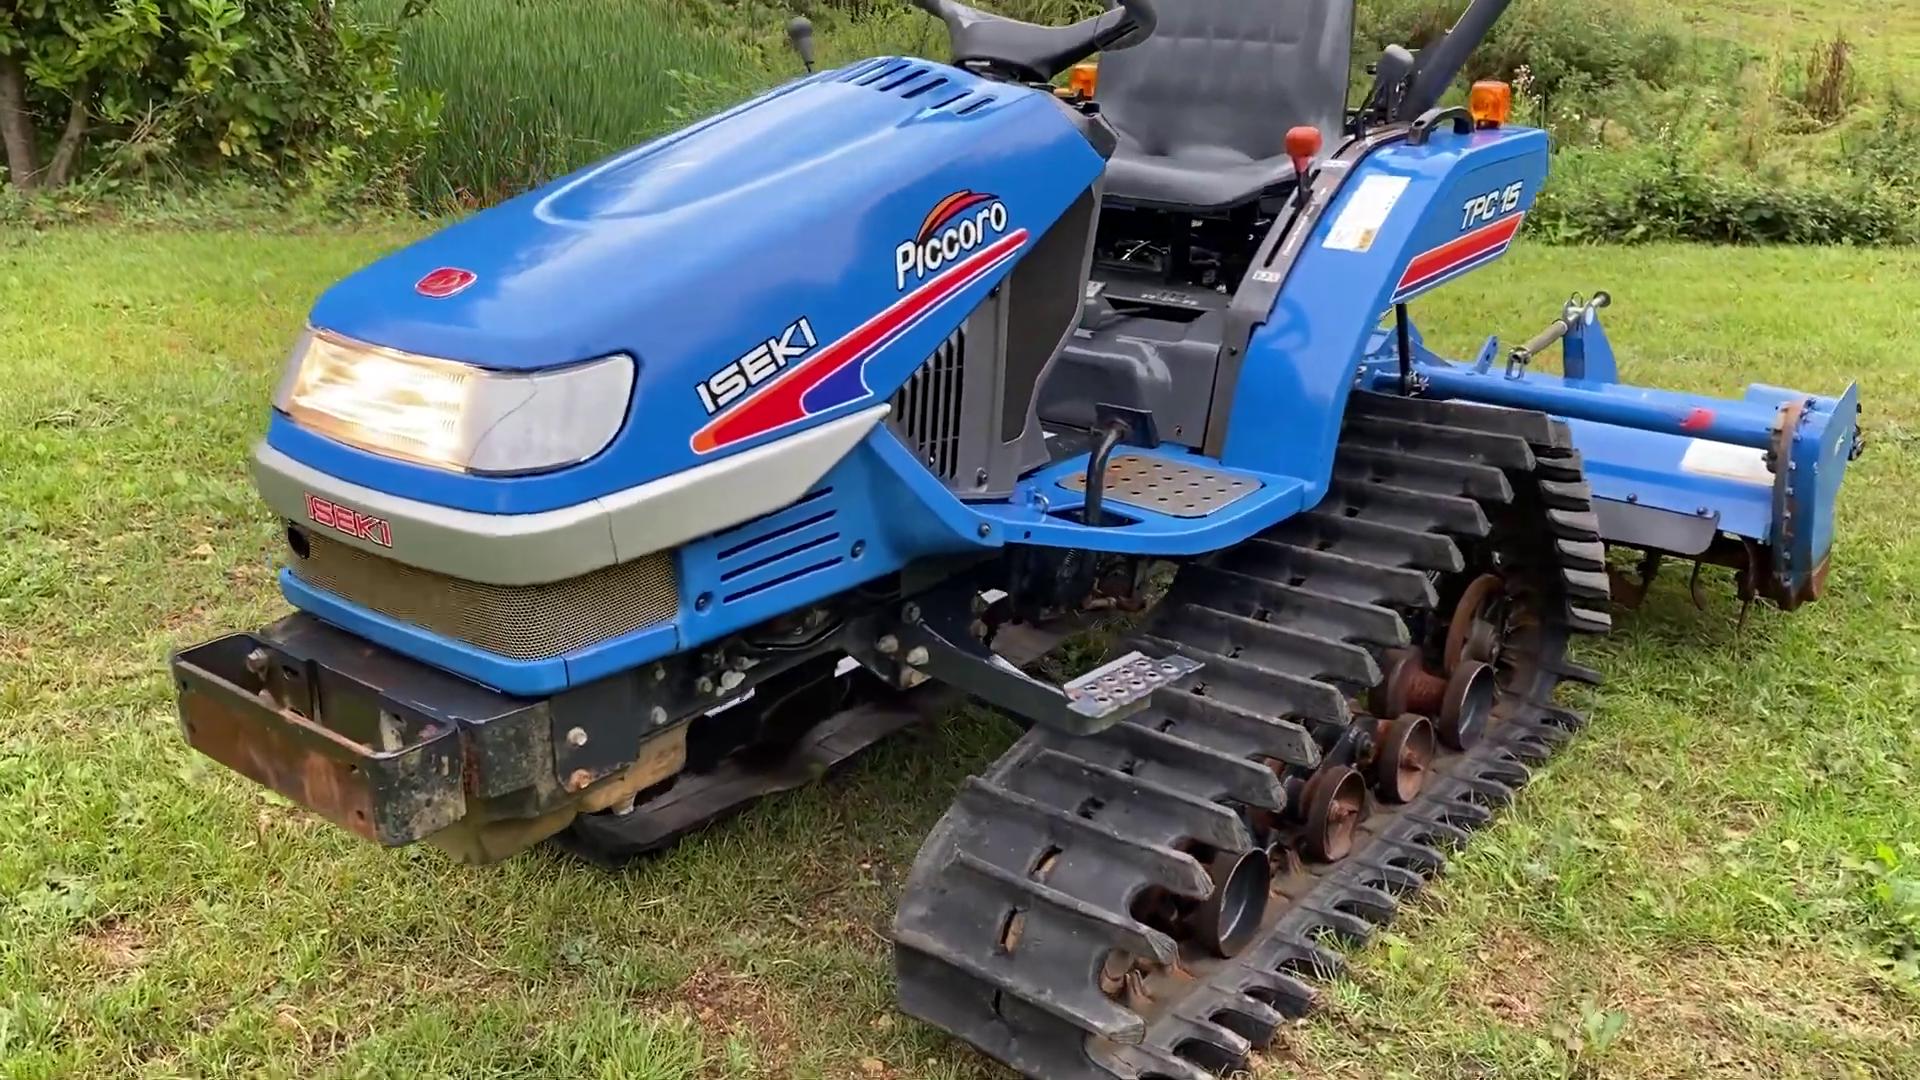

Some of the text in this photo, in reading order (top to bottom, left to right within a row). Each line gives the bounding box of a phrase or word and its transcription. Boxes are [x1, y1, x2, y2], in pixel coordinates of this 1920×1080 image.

[1461, 180, 1524, 230] TPC 15
[895, 201, 1008, 289] Piccoro
[695, 316, 818, 414] ISEKI
[304, 494, 393, 547] ISEKI
